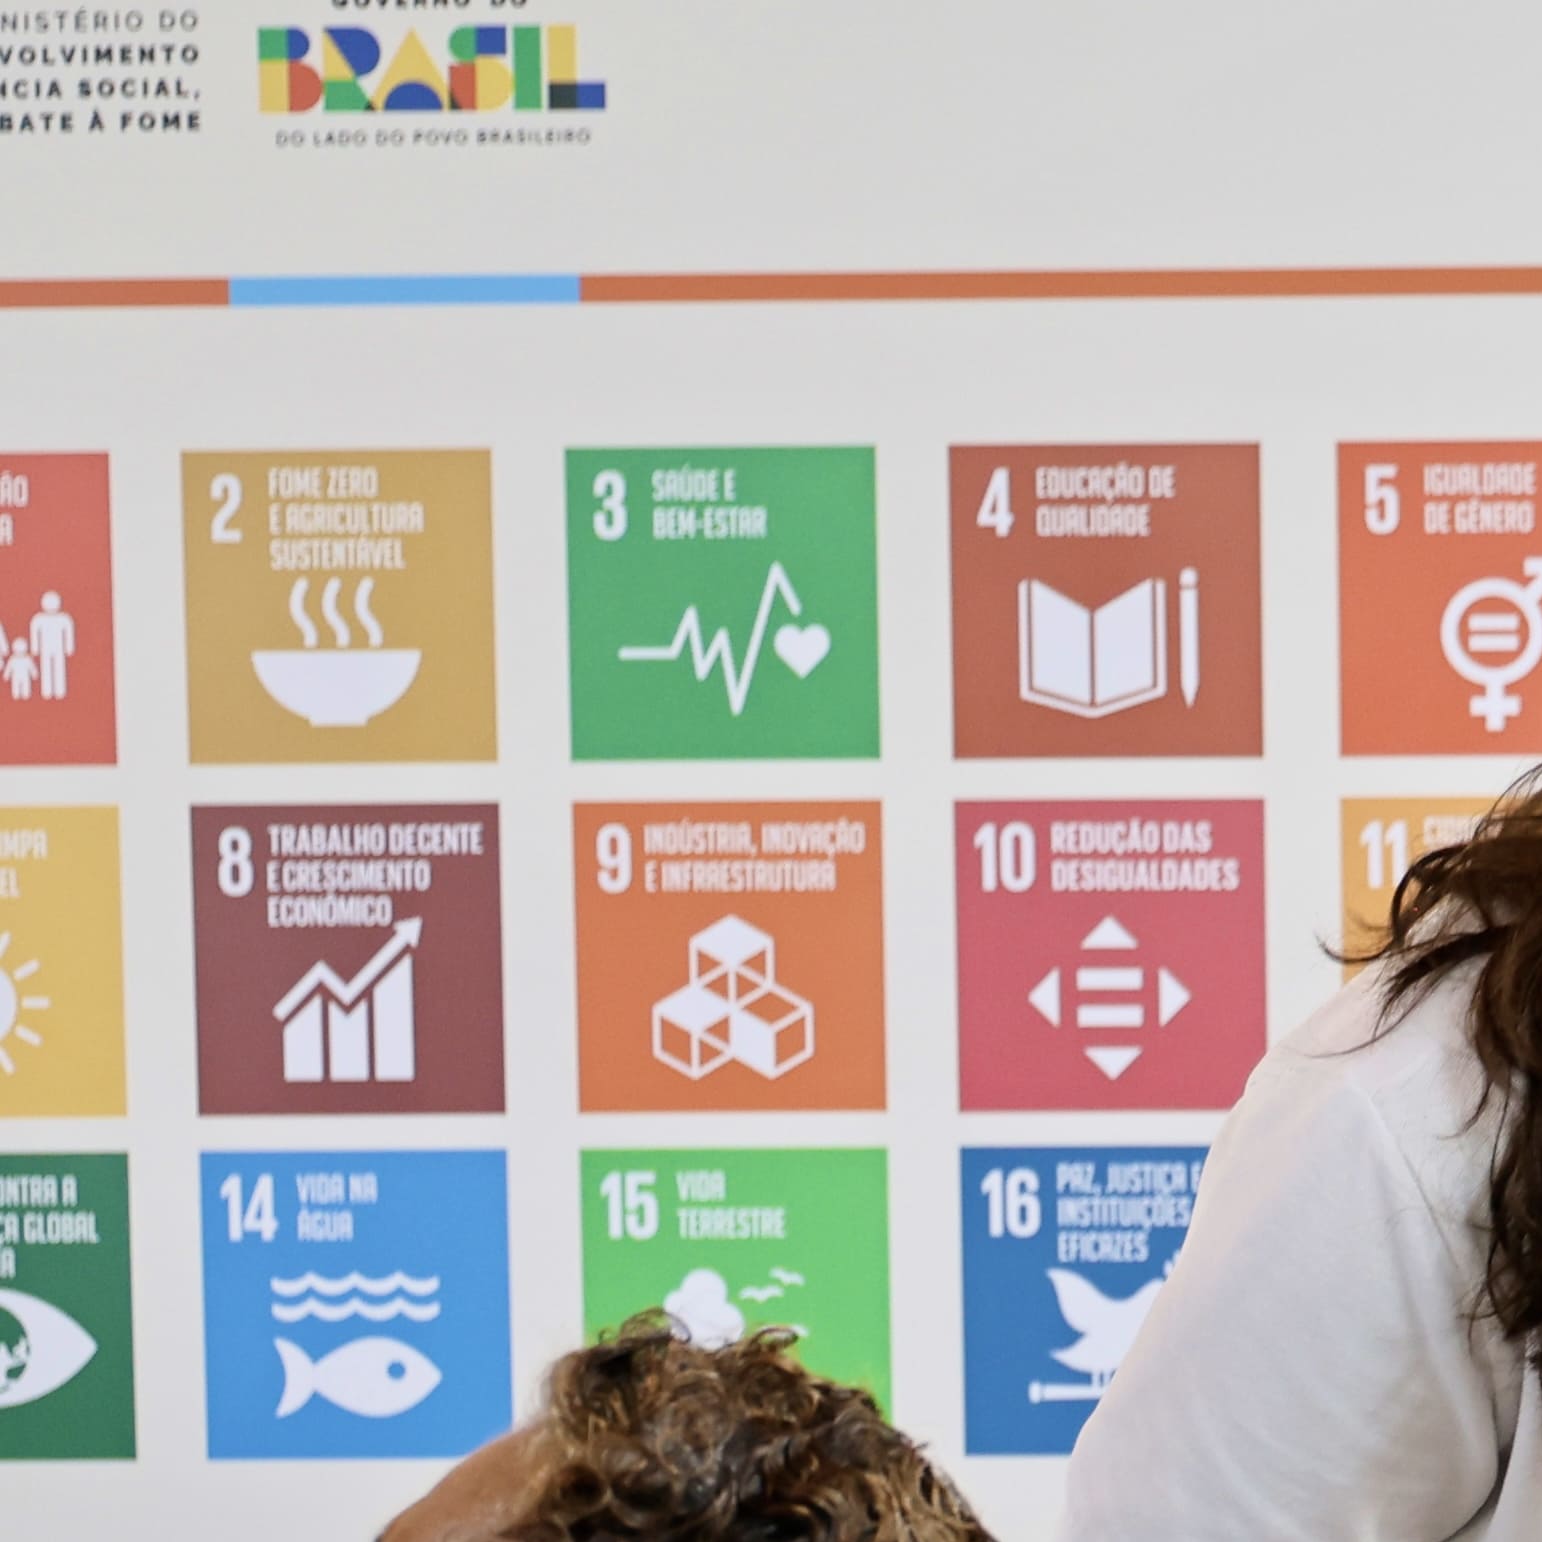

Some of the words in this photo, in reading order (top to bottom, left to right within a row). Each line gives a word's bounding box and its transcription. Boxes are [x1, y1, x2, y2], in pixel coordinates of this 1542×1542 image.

[159, 10, 198, 32] DO
[258, 23, 606, 113] BRASIL
[78, 78, 200, 100] SOCIAL,
[89, 108, 104, 132] À
[120, 111, 200, 133] FOME
[276, 131, 304, 146] DO
[314, 131, 367, 146] LADO
[376, 131, 404, 146] DO
[413, 130, 468, 146] POVO
[477, 129, 592, 146] BRASILEIRO
[268, 466, 322, 498] FOME
[327, 466, 379, 498] ZERO
[652, 463, 719, 501] SAÚDE
[724, 468, 736, 500] E
[1035, 460, 1145, 505] EDUCAÇÃO
[1149, 465, 1176, 498] DE
[1424, 462, 1537, 495] IGUALDADE
[210, 473, 243, 543] 2
[593, 469, 627, 541] 3
[977, 466, 1015, 537] 4
[1364, 464, 1400, 535] 5
[1424, 501, 1451, 534] DE
[1454, 497, 1535, 534] GÊNERO
[269, 503, 281, 535] E
[286, 502, 425, 534] AGRICULTURA
[653, 505, 768, 540] BEM-ESTAR
[1035, 504, 1150, 537] QUALIDADE
[270, 534, 405, 570] SUSTENTÁVEL
[268, 824, 385, 856] TRABALHO
[389, 822, 483, 855] DECENTE
[644, 817, 757, 857] INDÚSTRIA,
[761, 816, 866, 859] INOVAÇÃO
[1051, 817, 1160, 856] REDUÇÃO
[1163, 821, 1212, 853] DAS
[1359, 819, 1408, 889] 11
[218, 826, 253, 897] 8
[596, 823, 632, 894] 9
[974, 821, 1036, 893] 10
[267, 860, 280, 892] E
[282, 860, 431, 892] CRESCIMENTO
[645, 861, 656, 893] E
[661, 860, 836, 892] INFRAESTRUTURA
[1051, 859, 1240, 892] DESIGUALDADES
[268, 892, 392, 928] ECONÔMICO
[61, 1173, 78, 1208] A
[297, 1173, 344, 1203] VIDA
[349, 1173, 378, 1203] NA
[676, 1170, 726, 1201] VIDA
[1057, 1162, 1099, 1196] PAZ,
[1107, 1162, 1187, 1196] JUSTIÇA
[221, 1173, 278, 1242] 14
[601, 1170, 659, 1240] 15
[981, 1168, 1041, 1238] 16
[1058, 1195, 1191, 1233] INSTITUIÇÕES
[24, 1210, 100, 1244] GLOBAL
[298, 1209, 353, 1241] ÁGUA
[678, 1207, 785, 1239] TERRESTRE
[1057, 1231, 1148, 1262] EFICAZES
